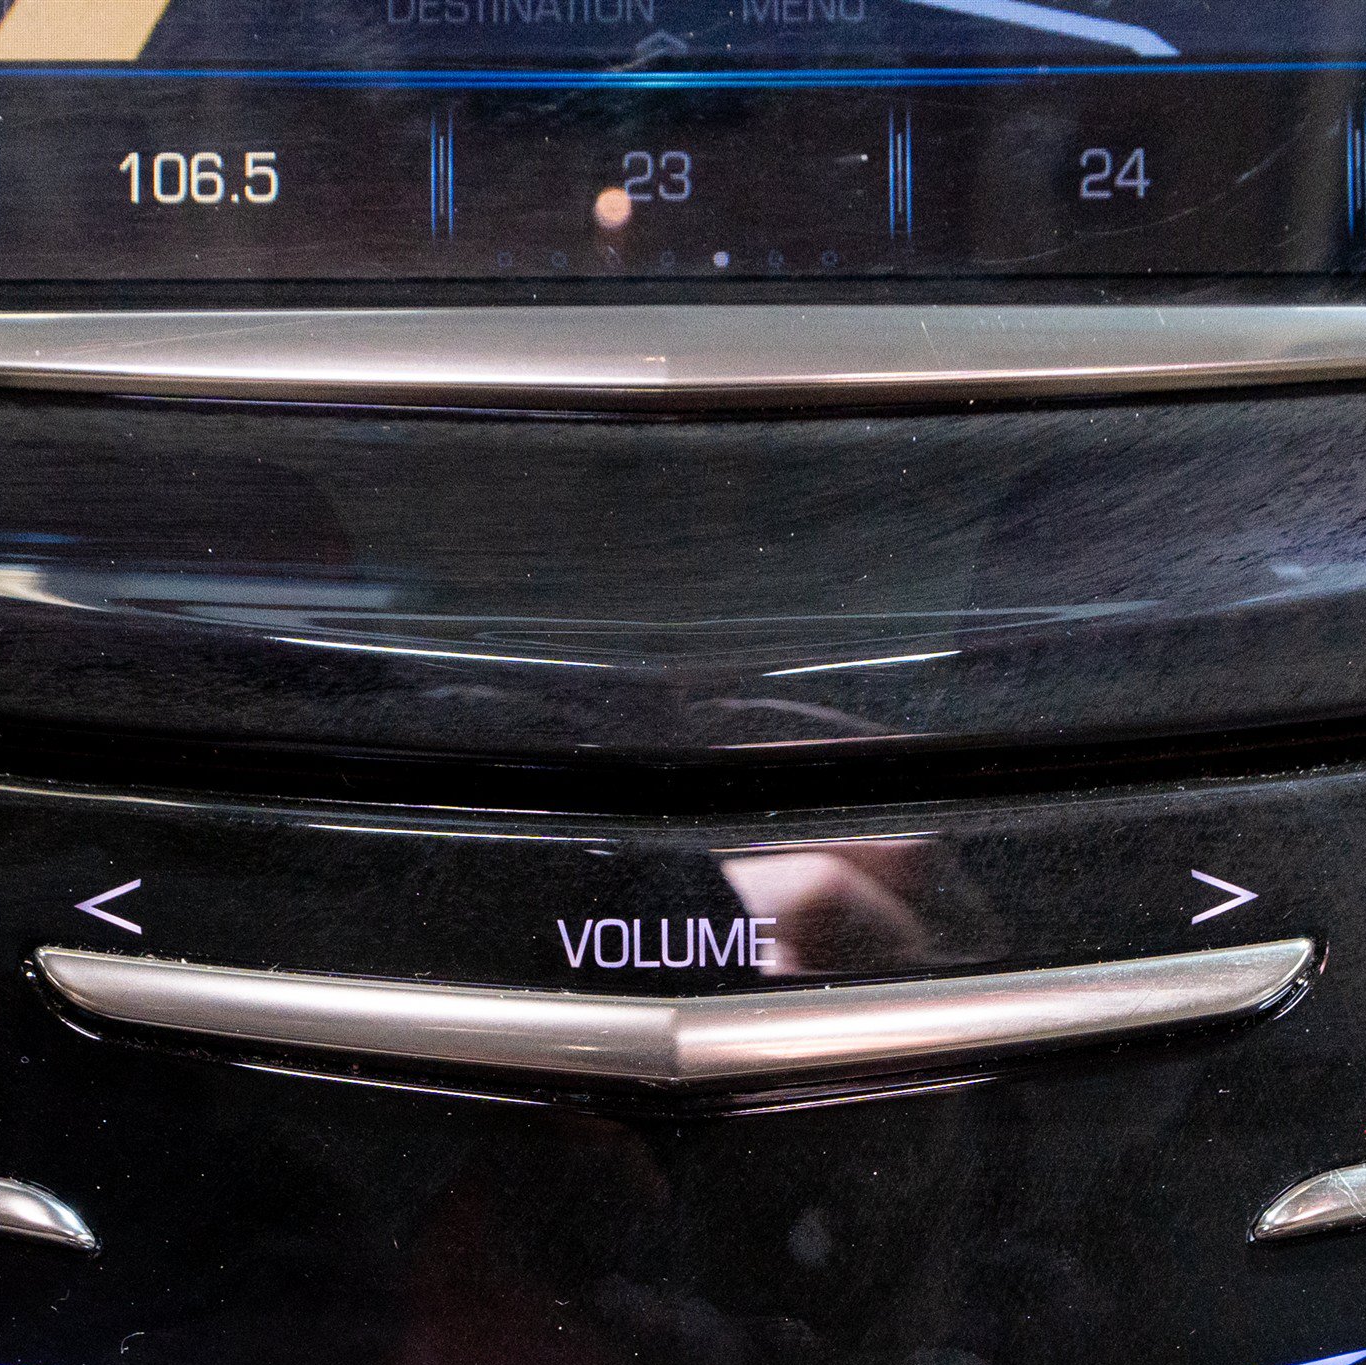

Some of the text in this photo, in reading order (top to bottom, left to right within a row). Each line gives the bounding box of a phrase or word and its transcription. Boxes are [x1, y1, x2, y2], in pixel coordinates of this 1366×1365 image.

[119, 152, 280, 204] 106.5
[622, 151, 693, 202] 23
[1080, 148, 1151, 199] 24
[557, 917, 778, 968] VOLUME
